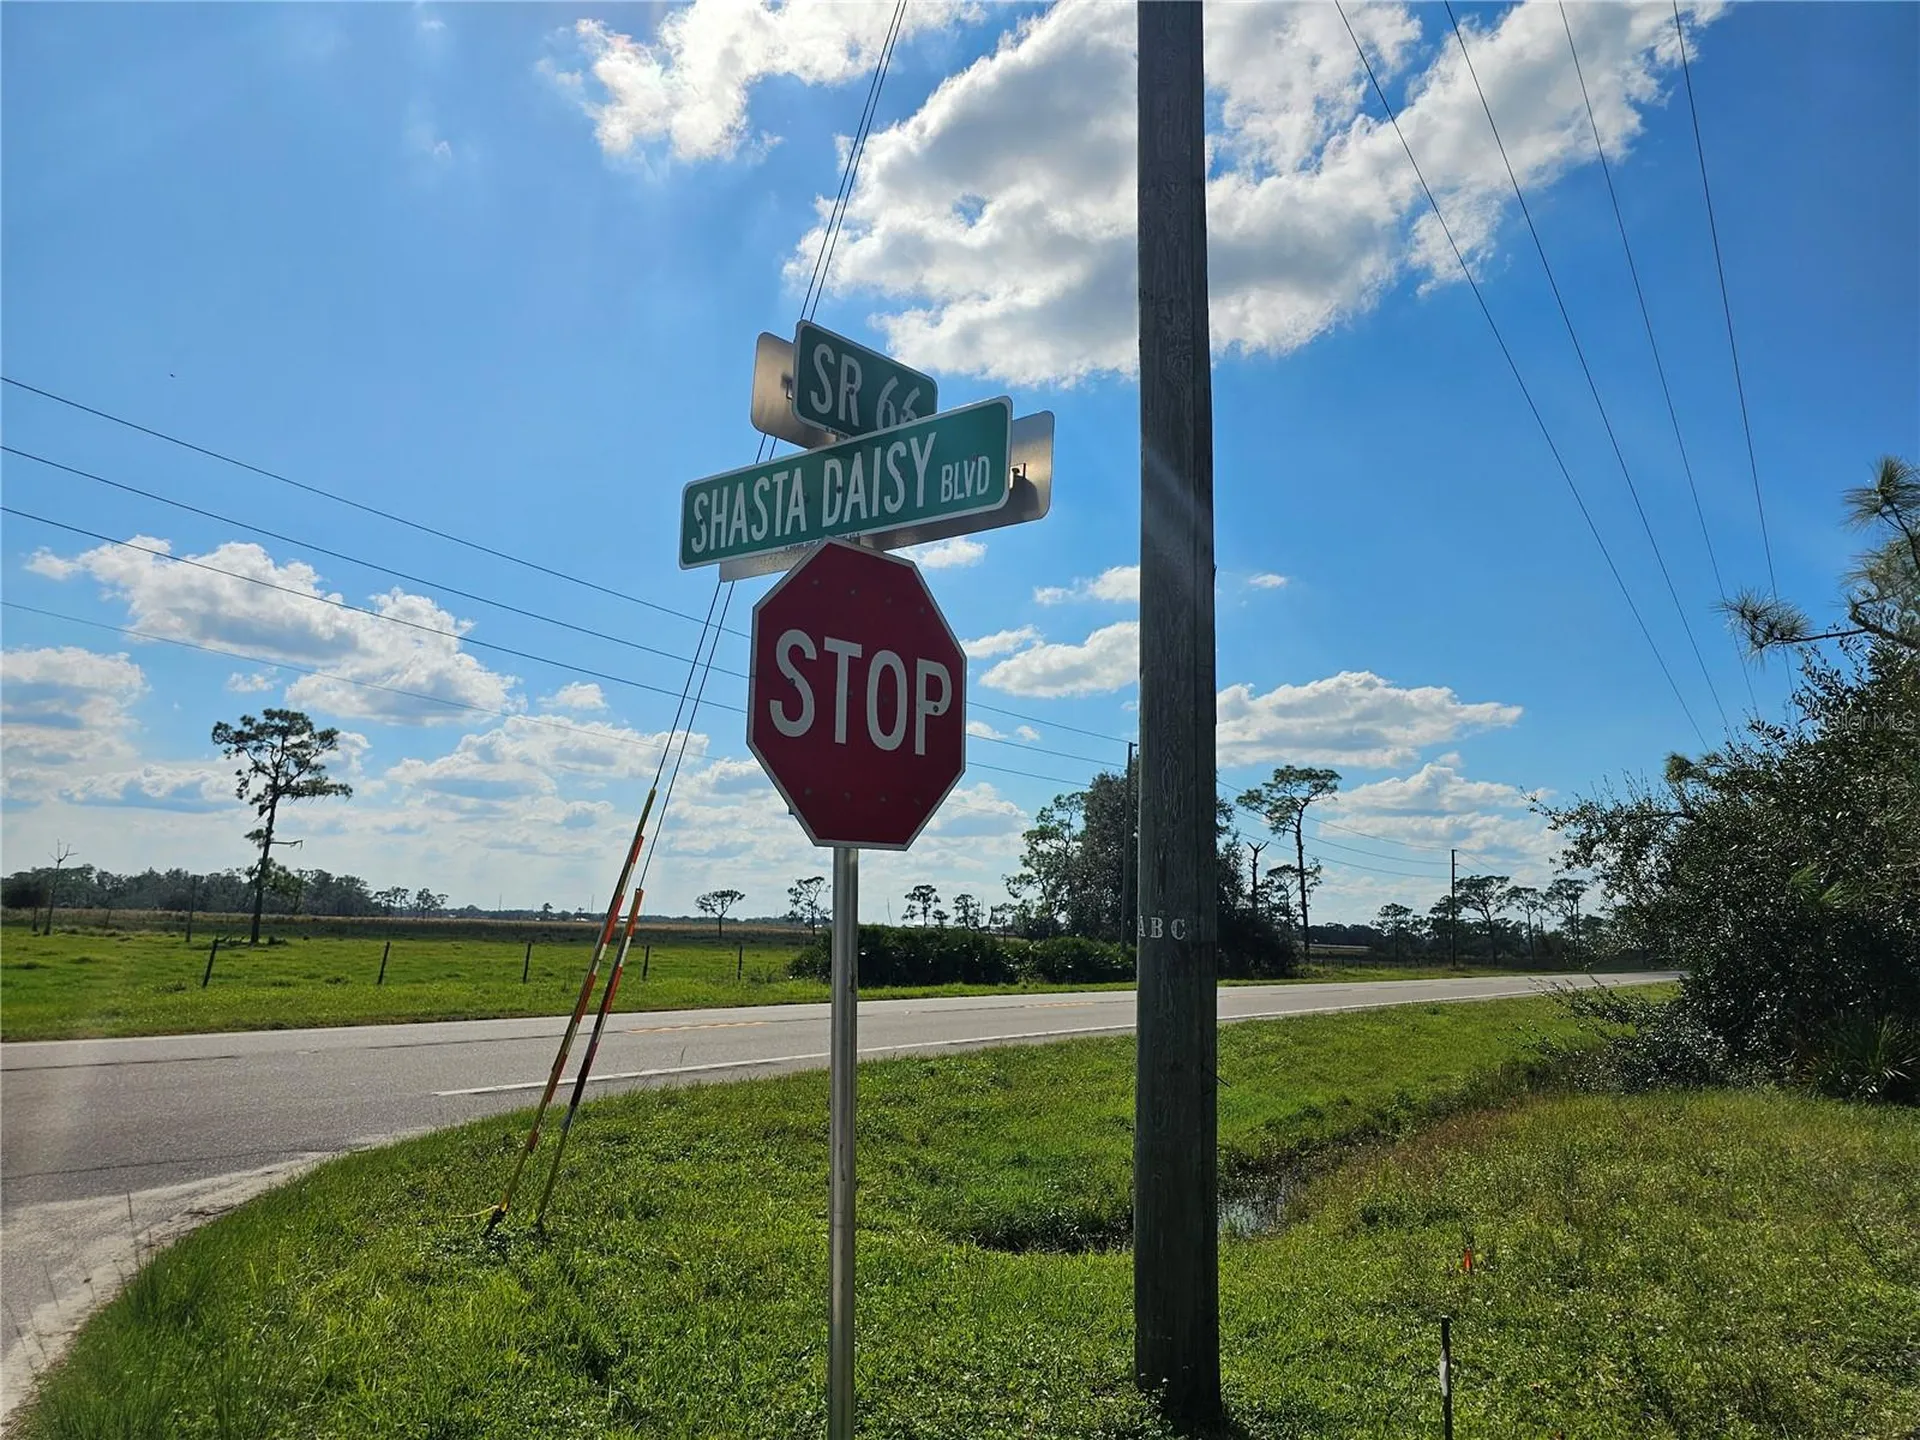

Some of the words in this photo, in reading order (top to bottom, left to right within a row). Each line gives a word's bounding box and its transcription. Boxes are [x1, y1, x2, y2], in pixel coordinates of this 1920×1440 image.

[810, 343, 862, 427] SR
[876, 375, 921, 430] 66
[691, 467, 806, 553] SHASTA
[822, 432, 937, 528] DAISY
[940, 455, 990, 503] BLVD
[769, 629, 952, 756] STOP
